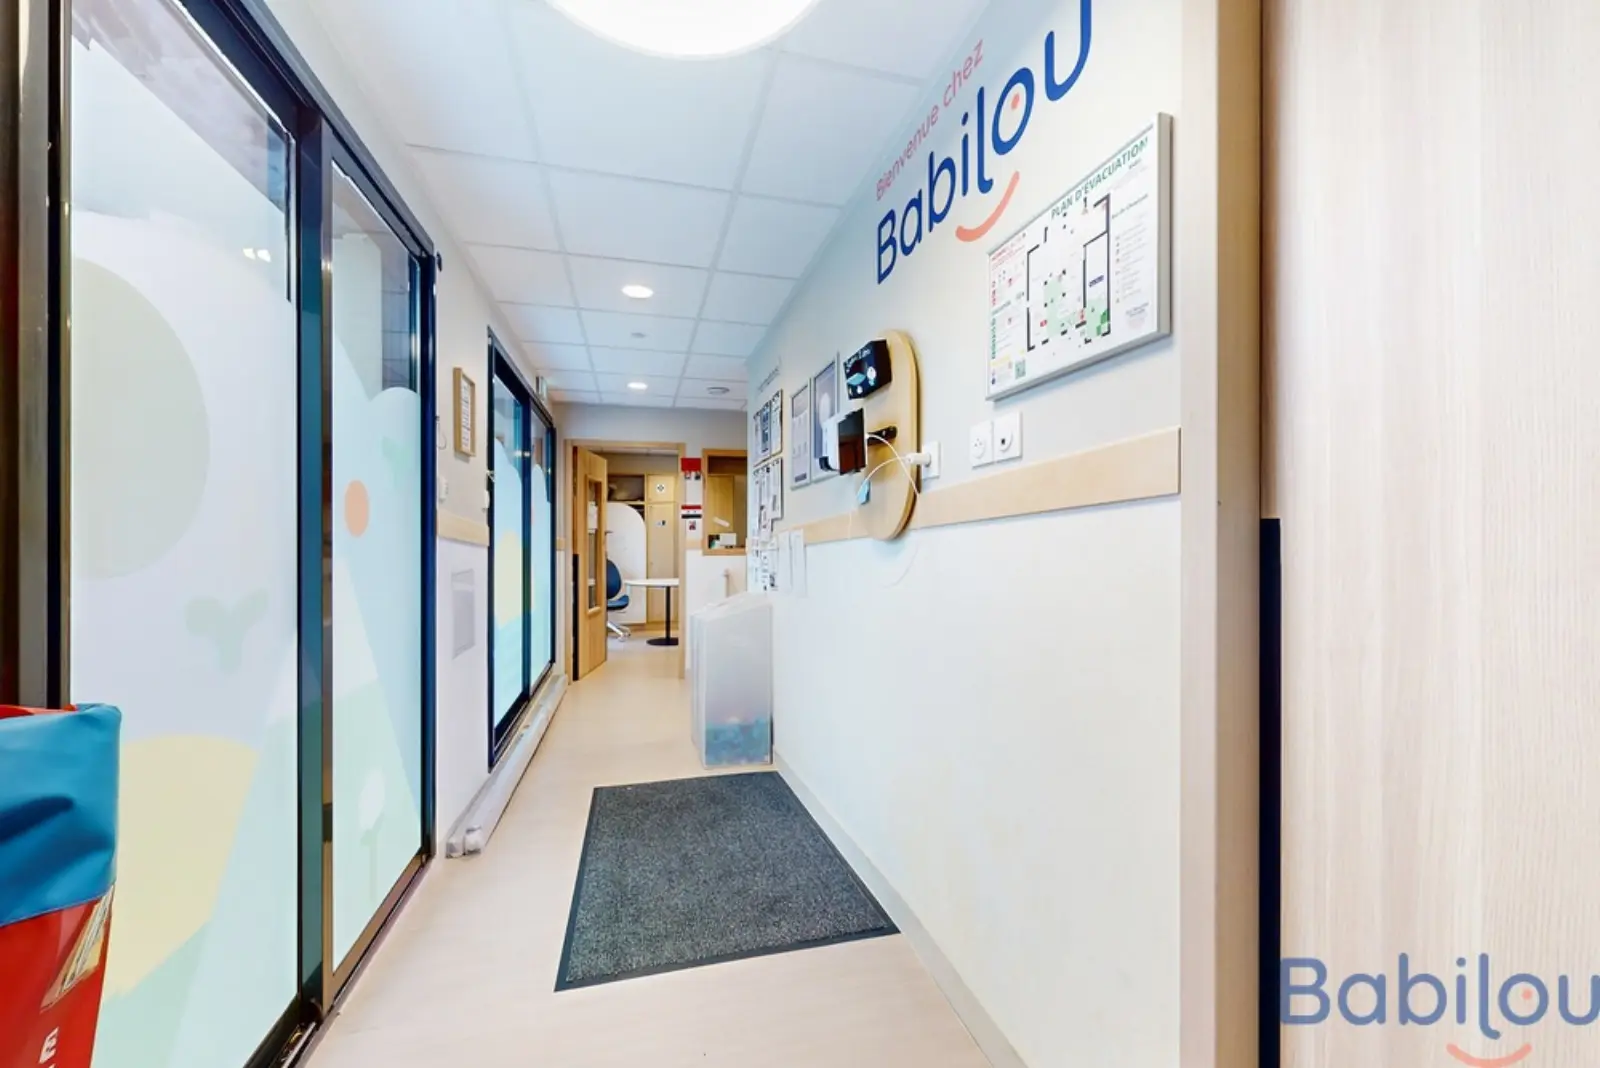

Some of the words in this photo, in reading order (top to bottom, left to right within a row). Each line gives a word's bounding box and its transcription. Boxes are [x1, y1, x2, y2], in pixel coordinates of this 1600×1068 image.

[876, 105, 940, 202] Bienvenue
[943, 39, 984, 108] chez
[877, 0, 1092, 285] Babilou
[1051, 194, 1073, 220] PLAN
